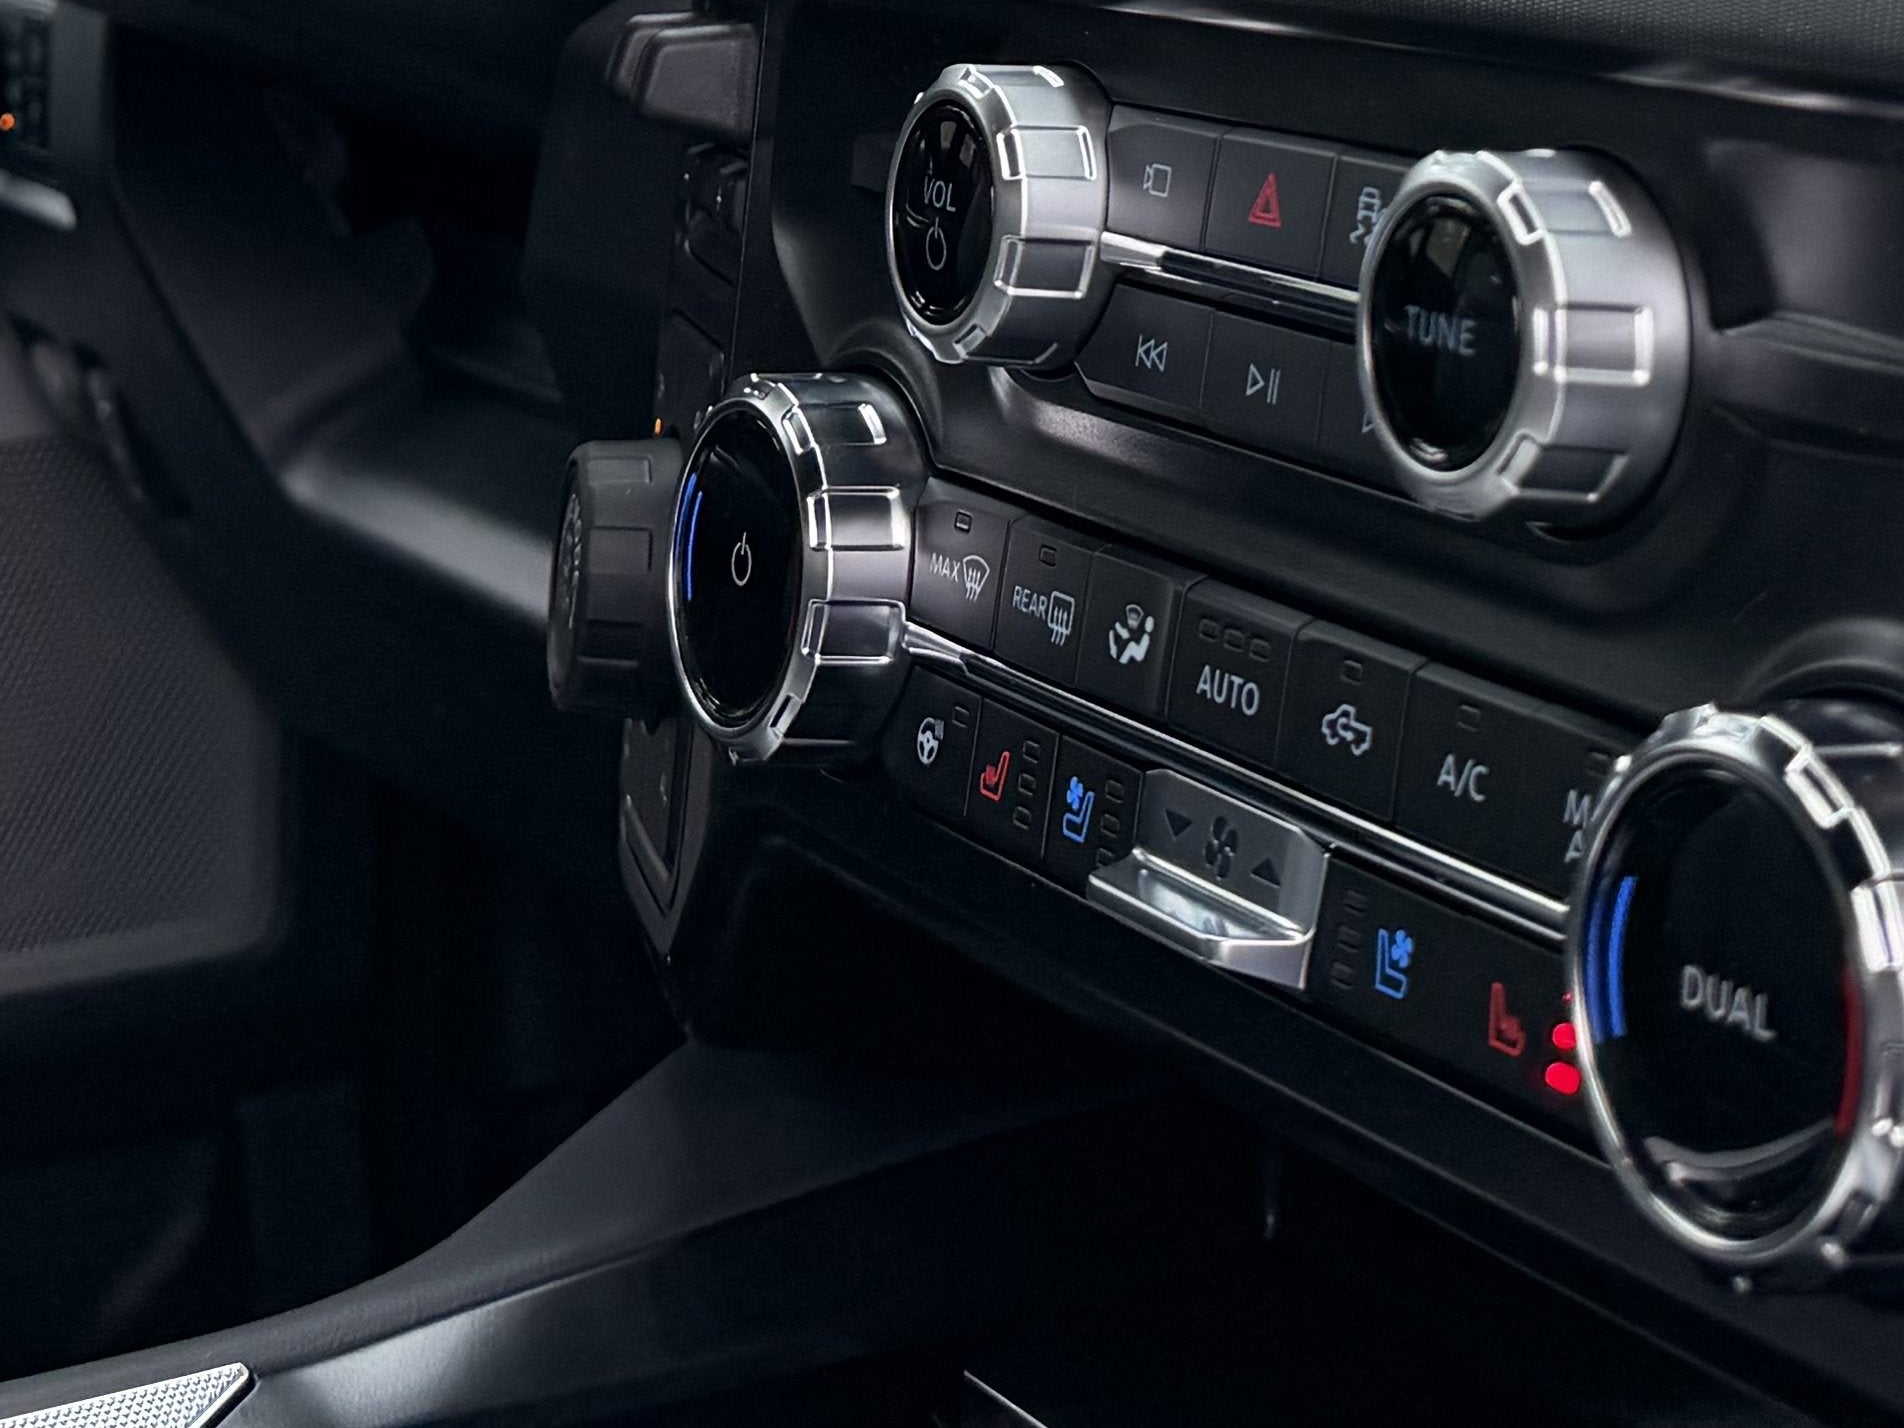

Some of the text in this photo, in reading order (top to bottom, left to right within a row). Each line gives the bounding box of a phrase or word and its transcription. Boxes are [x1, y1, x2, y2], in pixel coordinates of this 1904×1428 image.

[924, 176, 956, 212] VOL
[1404, 304, 1475, 357] TUNE
[929, 552, 960, 581] MAX
[1012, 585, 1046, 619] REAR
[1196, 664, 1259, 716] AUTO
[1437, 753, 1489, 803] A/C
[1680, 963, 1777, 1042] DUAL
